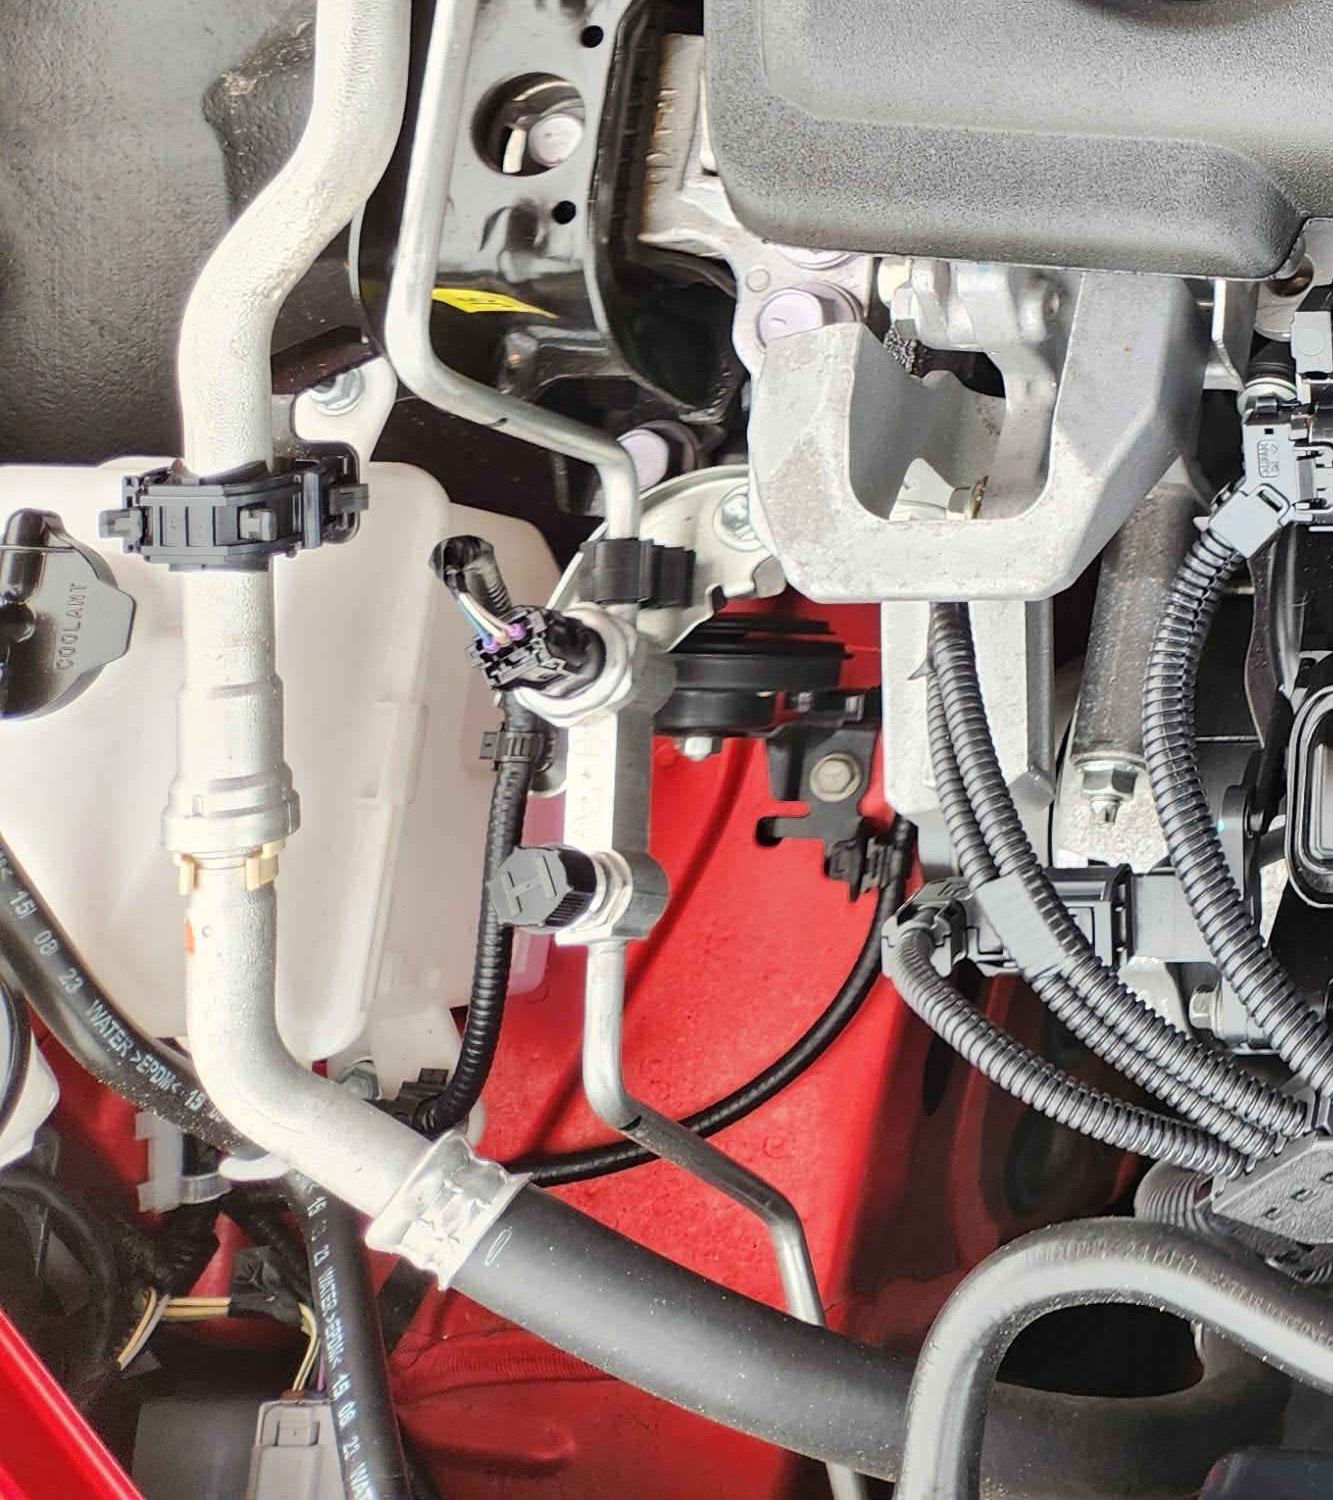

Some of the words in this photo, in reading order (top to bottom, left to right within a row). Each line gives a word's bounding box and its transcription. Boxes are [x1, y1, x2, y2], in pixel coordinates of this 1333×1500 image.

[56, 581, 88, 671] COOLANT
[33, 930, 59, 957] 08
[58, 967, 83, 995] 23
[86, 999, 134, 1057] WATER
